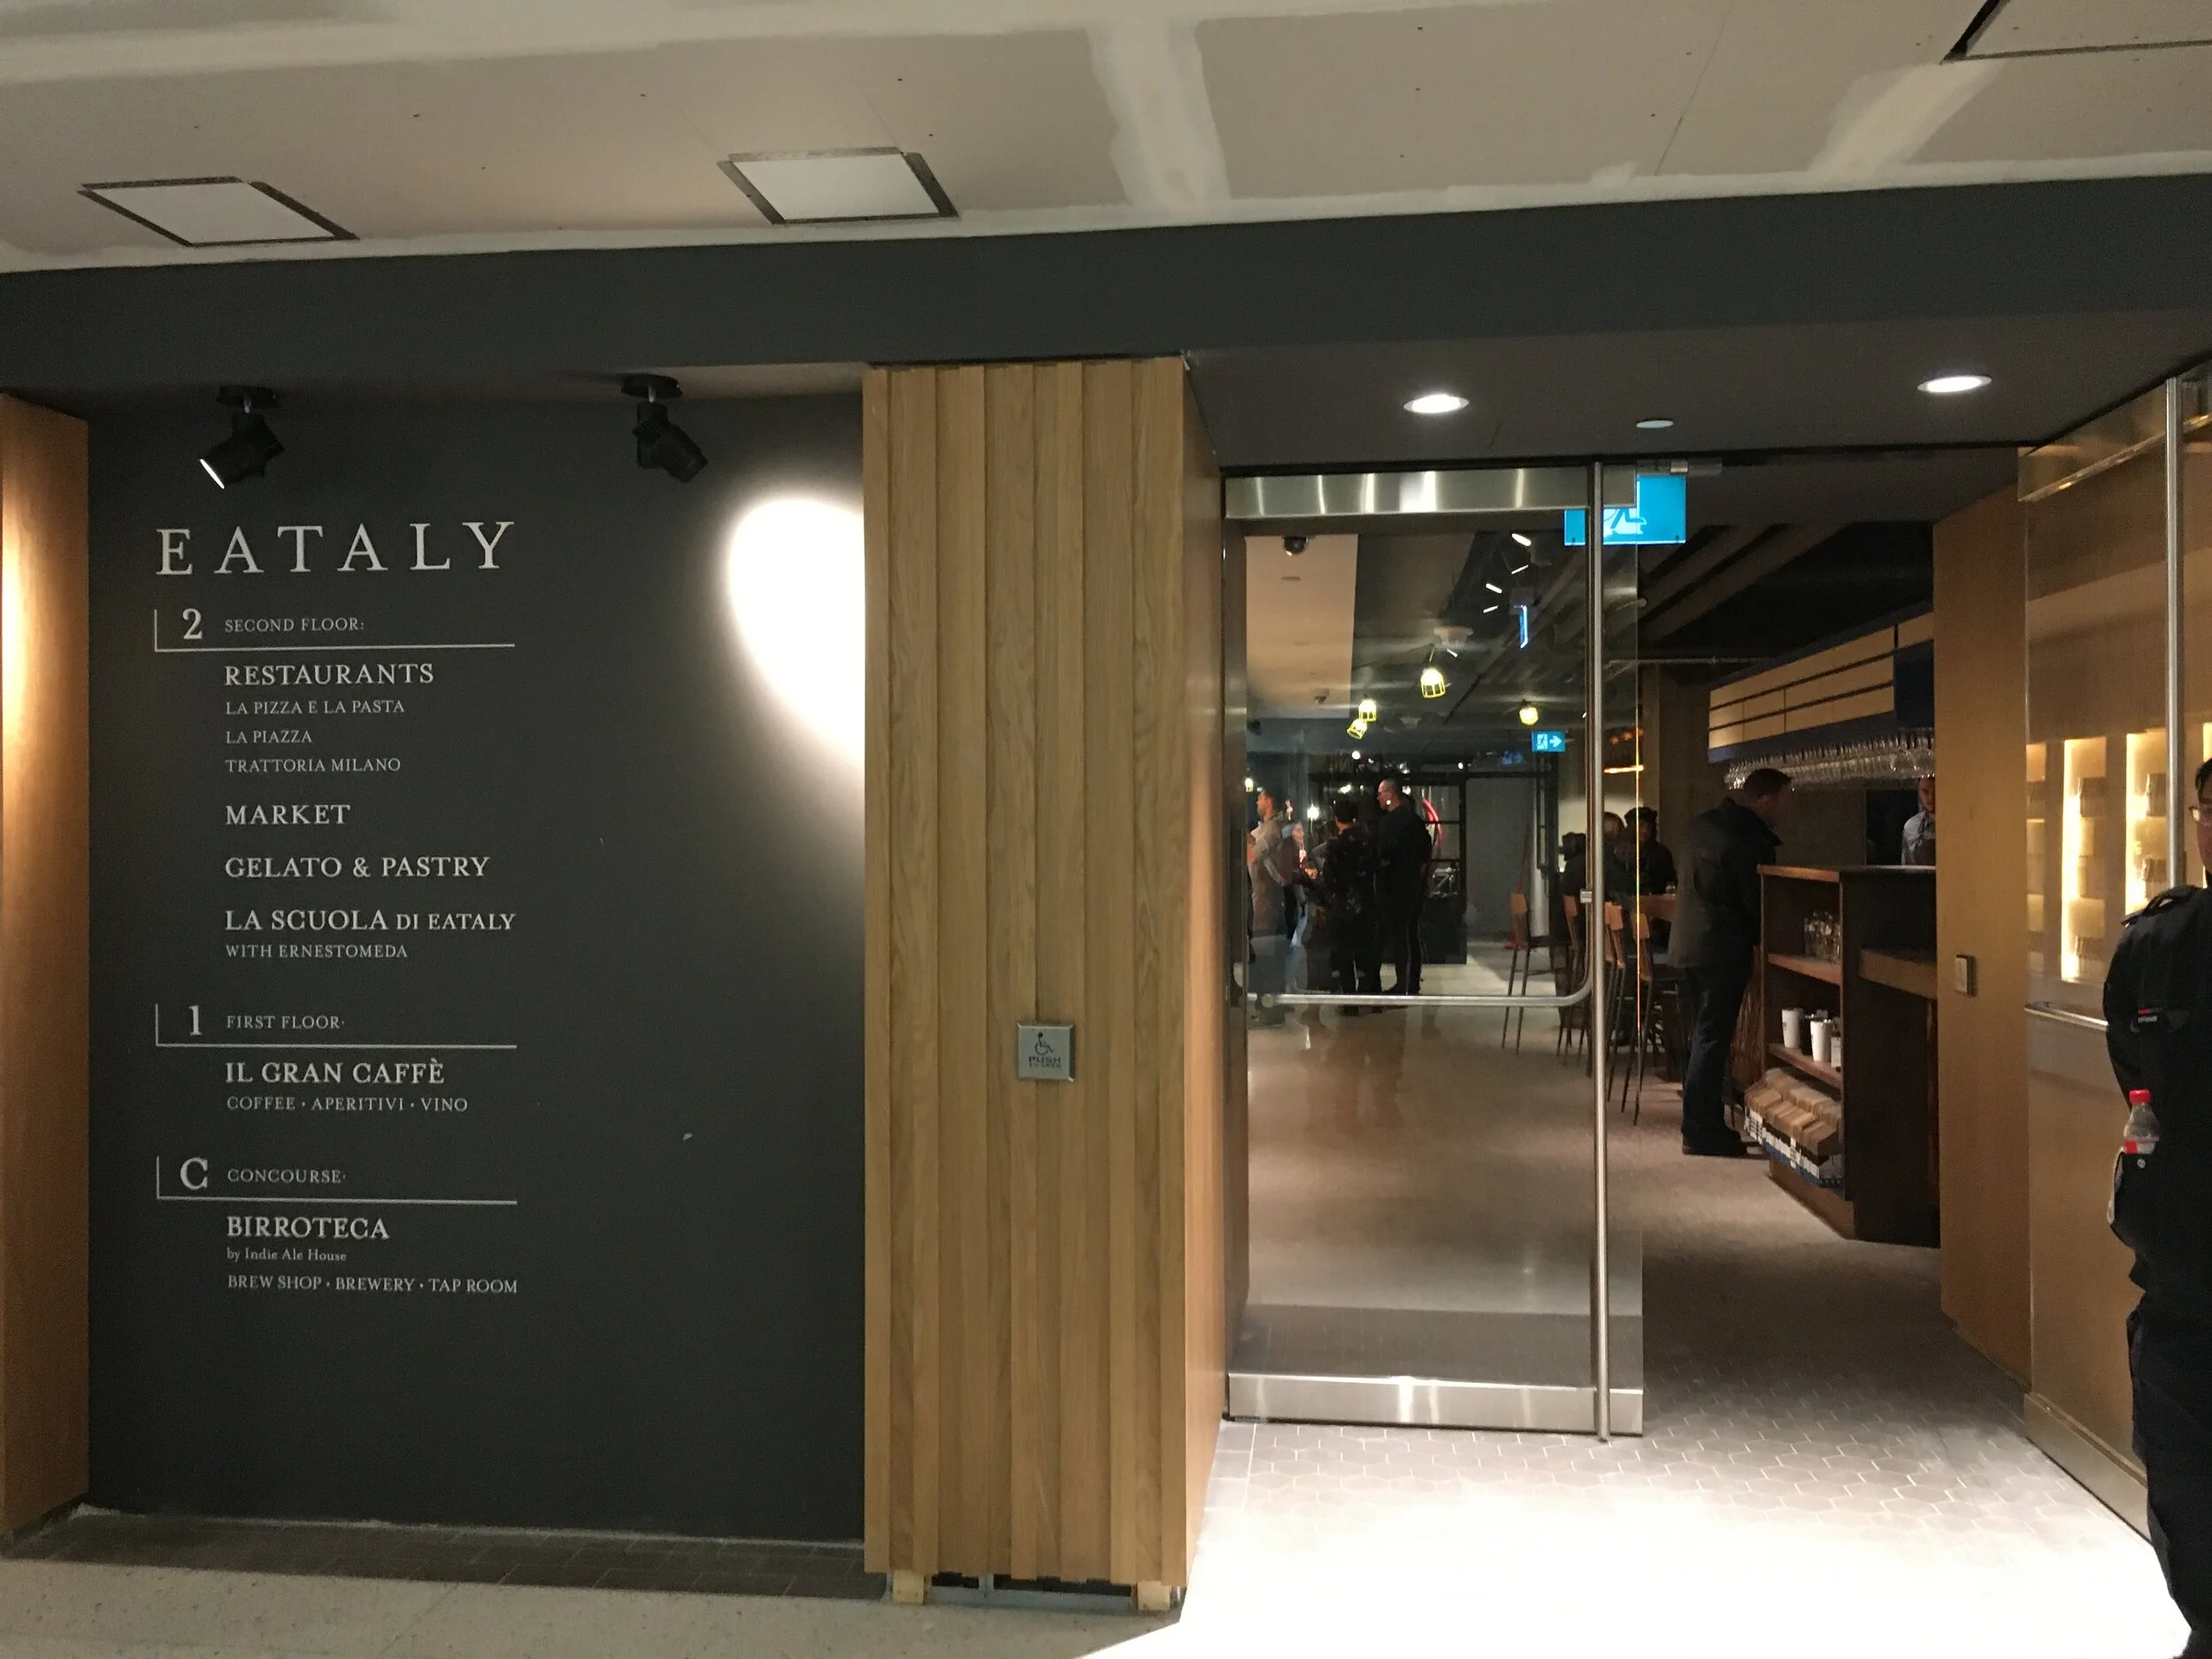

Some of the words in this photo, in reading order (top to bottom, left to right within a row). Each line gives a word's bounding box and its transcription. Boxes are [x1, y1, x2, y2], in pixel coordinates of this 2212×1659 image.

[156, 520, 515, 576] EATALY
[182, 608, 204, 640] 2
[225, 618, 295, 633] SECOND
[301, 617, 365, 632] FLOOR:
[224, 663, 434, 686] RESTAURANTS
[226, 702, 249, 715] LA
[254, 701, 303, 715] PIZZA
[308, 700, 318, 714] E
[324, 700, 347, 714] LA
[352, 699, 405, 714] PASTA
[226, 730, 248, 744] LA
[253, 730, 312, 744] PIAZZA
[226, 758, 326, 773] TRATTORIA
[331, 757, 401, 772] MILANO
[226, 803, 351, 826] MARKET
[225, 856, 342, 879] GELATO
[352, 856, 372, 878] &
[381, 856, 491, 878] PASTRY
[225, 910, 264, 931] LA
[271, 909, 388, 931] SCUOLA
[396, 913, 419, 931] DI
[427, 913, 517, 931] EATALY
[226, 944, 273, 958] WITH
[279, 943, 408, 958] ERNESTOMEDA
[188, 1004, 203, 1037] 1
[227, 1015, 276, 1029] FIRST
[226, 1062, 254, 1084] IL
[261, 1062, 343, 1084] GRAN
[352, 1057, 445, 1085] CAFFÈ
[227, 1095, 296, 1111] COFFEE
[311, 1096, 403, 1112] APERITIVI
[420, 1097, 468, 1112] VINO
[180, 1156, 209, 1191] C
[227, 1216, 390, 1240] BIRROTECA
[227, 1247, 241, 1263] by
[244, 1247, 278, 1262] Indie
[281, 1248, 303, 1261] Ale
[307, 1248, 348, 1263] House
[227, 1274, 273, 1289] BREW
[277, 1275, 322, 1290] SHOP
[335, 1277, 415, 1292] BREWERY
[427, 1278, 462, 1293] TAP
[465, 1279, 518, 1294] ROOM
